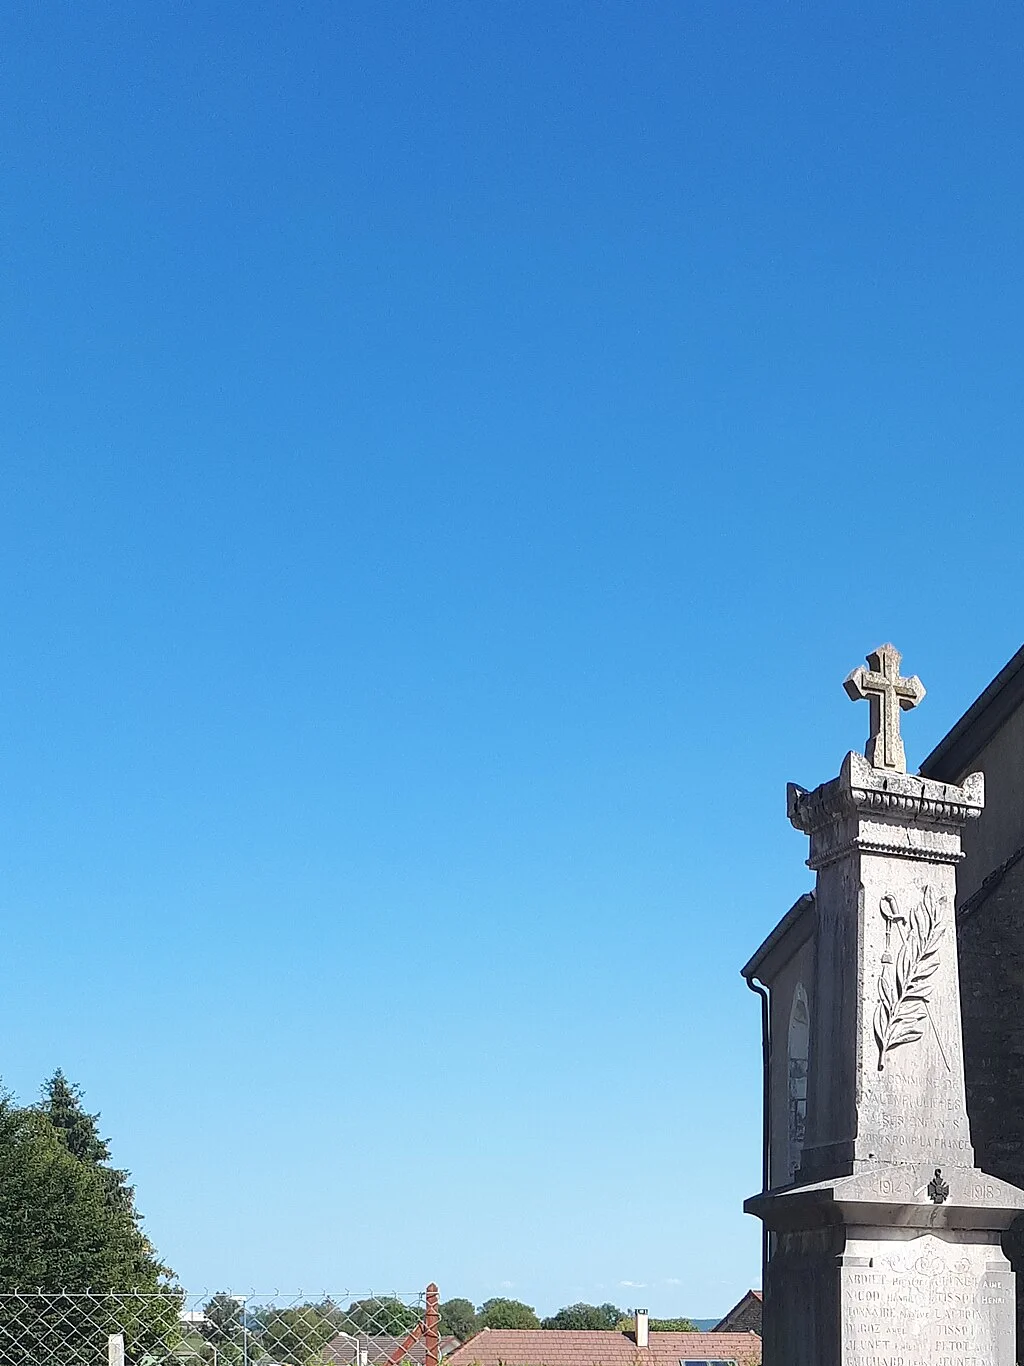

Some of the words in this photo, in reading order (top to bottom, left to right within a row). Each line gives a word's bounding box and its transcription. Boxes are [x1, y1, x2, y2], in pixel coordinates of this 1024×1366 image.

[887, 1074, 939, 1088] COMMUNE
[919, 1136, 932, 1148] LA
[934, 1138, 971, 1150] FRANCE
[972, 1184, 994, 1199] 1918
[936, 1292, 976, 1304] TISSOT
[982, 1295, 1005, 1304] HENRI
